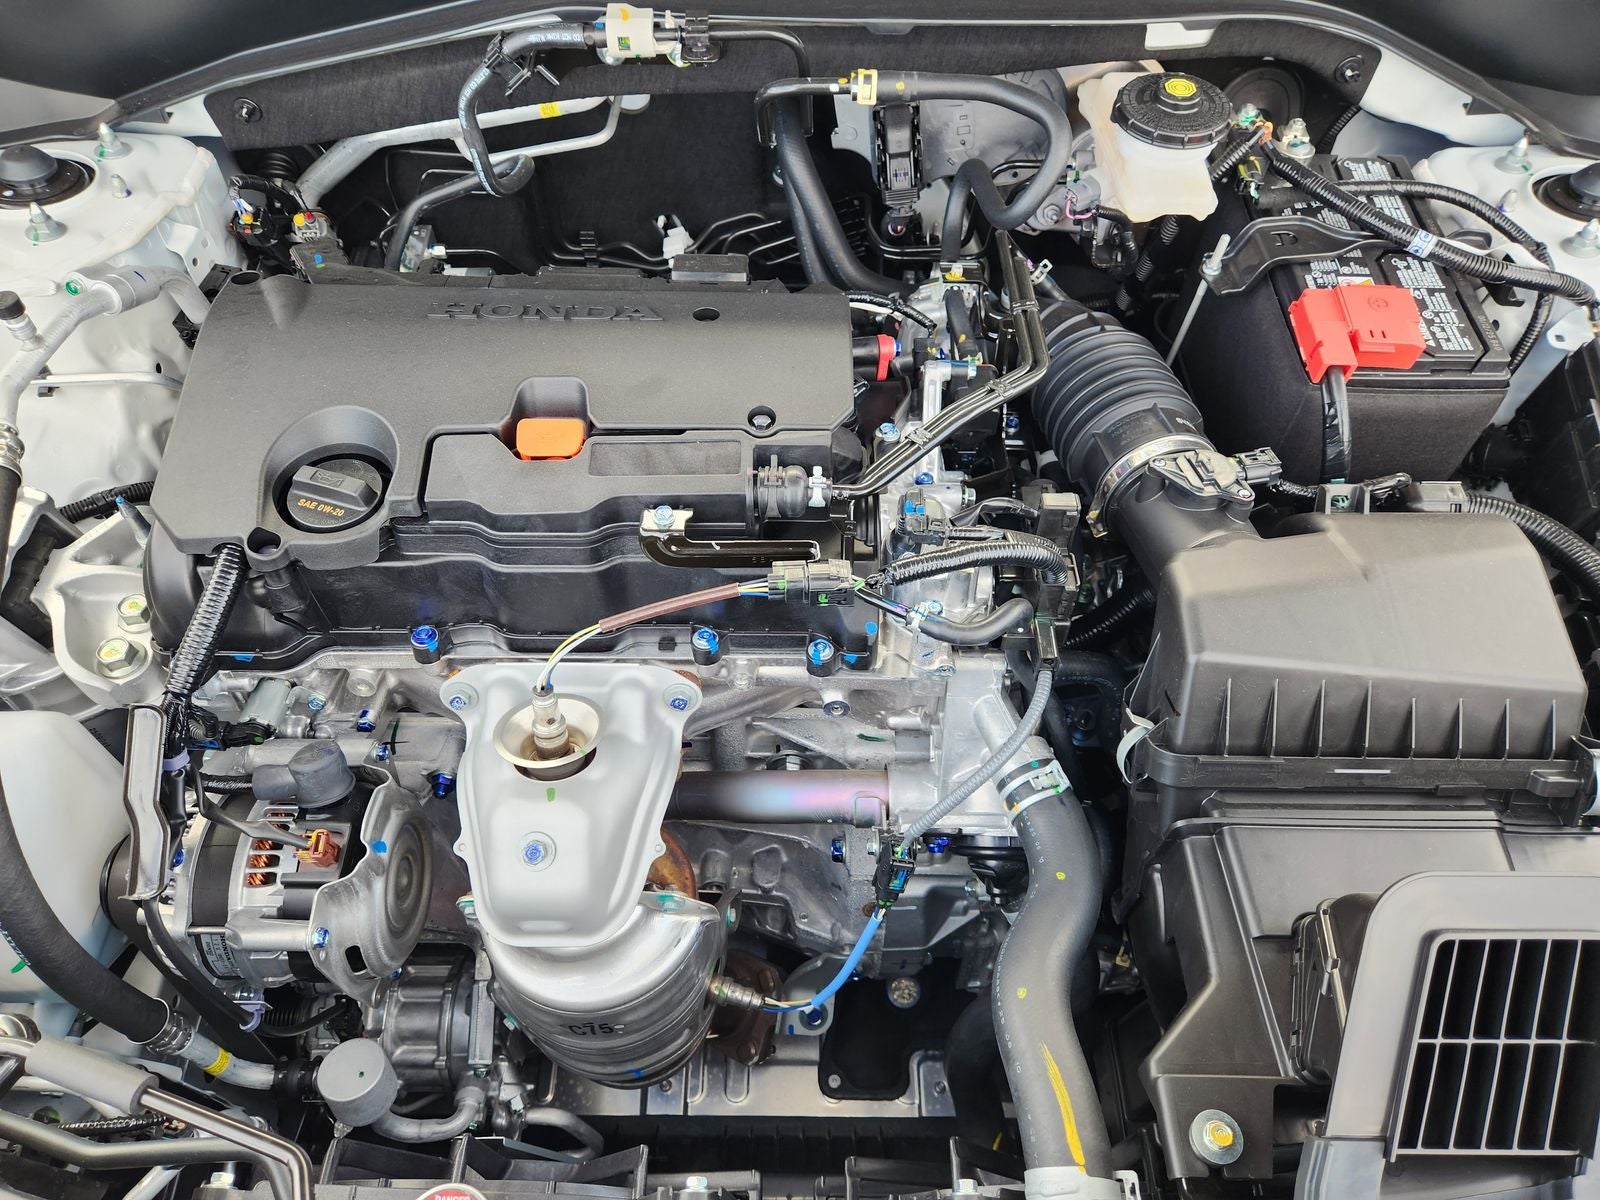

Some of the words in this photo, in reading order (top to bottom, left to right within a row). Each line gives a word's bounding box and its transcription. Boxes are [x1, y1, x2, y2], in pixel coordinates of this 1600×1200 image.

[427, 302, 664, 321] HONDA
[297, 498, 318, 510] SAE
[317, 503, 346, 517] 0W-20
